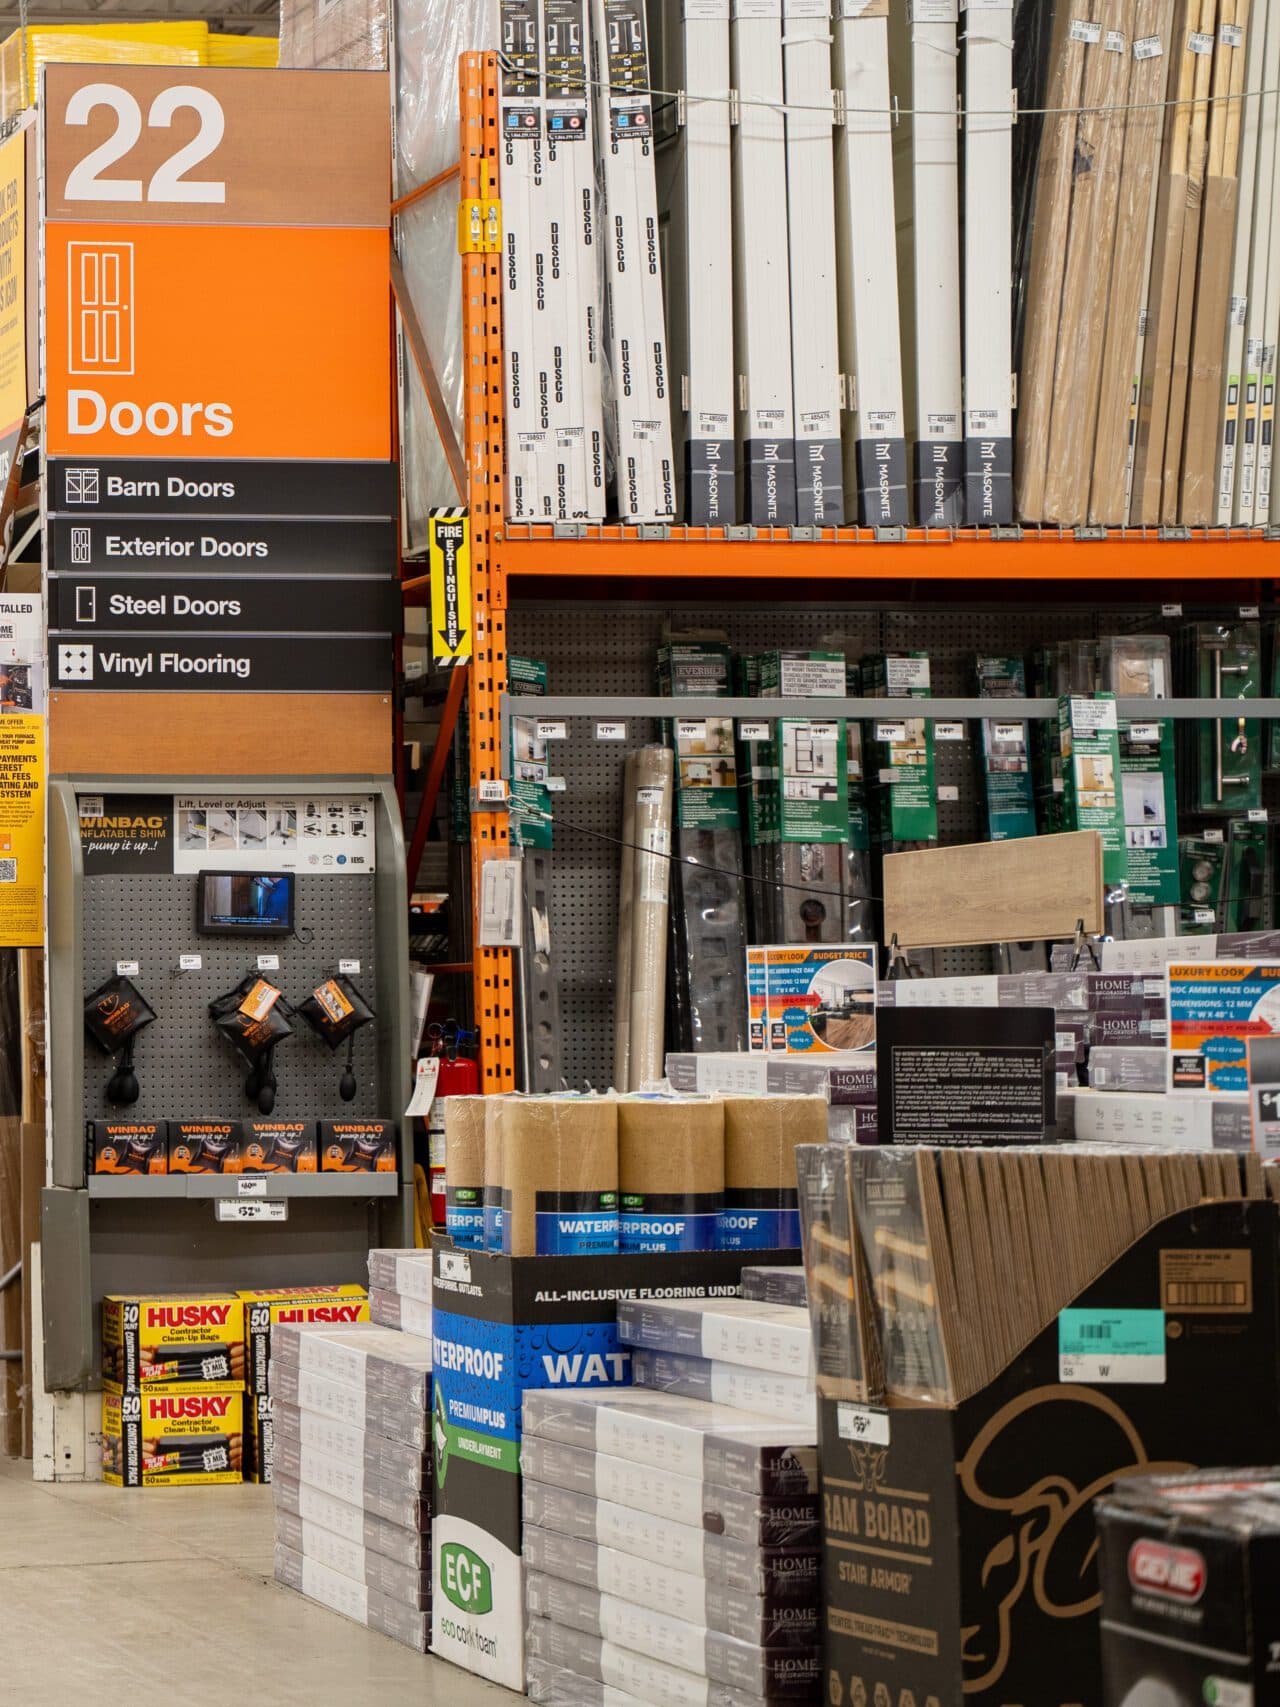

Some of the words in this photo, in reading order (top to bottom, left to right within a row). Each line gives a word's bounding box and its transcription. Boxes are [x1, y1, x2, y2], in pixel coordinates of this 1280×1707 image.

[64, 83, 226, 204] 22
[583, 188, 593, 246] DUSCO
[551, 222, 560, 280] DUSCO
[615, 215, 626, 273] DUSCO
[646, 216, 656, 276] DUSCO
[507, 233, 517, 291] DUSCO
[536, 253, 545, 311] DUSCO
[67, 389, 234, 437] Doors
[106, 477, 160, 498] Barn
[167, 477, 235, 498] Doors
[708, 464, 719, 518] MASONITE
[767, 465, 777, 519] MASONITE
[813, 465, 824, 520] MASONITE
[879, 464, 890, 519] MASONITE
[437, 525, 463, 539] FIRE
[105, 536, 194, 557] Exterior
[200, 537, 269, 558] Doors
[445, 539, 458, 648] EXTINGUISHER
[109, 595, 167, 615] Steel
[173, 596, 242, 616] Doors
[99, 653, 153, 678] Vinyl
[160, 653, 251, 678] Flooring
[12, 773, 31, 781] FEES
[23, 782, 39, 790] AND
[0, 790, 31, 798] SYSTEM
[178, 800, 197, 809] Lift,
[199, 800, 222, 809] Level
[236, 800, 266, 810] Adjust
[80, 816, 165, 828] WINBAG
[140, 829, 166, 838] SHIM
[813, 952, 842, 960] BUDGET
[1170, 968, 1211, 976] LUXURY
[1215, 968, 1245, 976] LOOK
[1096, 980, 1130, 990] HOME
[1171, 986, 1187, 994] HDC
[1189, 986, 1217, 994] AMBER
[1220, 986, 1241, 994] HAZE
[1243, 986, 1261, 994] OAK
[1103, 1020, 1137, 1030] HOME
[837, 1074, 872, 1084] HOME
[107, 1126, 156, 1134] WINBAG
[535, 1288, 637, 1302] ALL-INCLUSIVE
[640, 1287, 705, 1299] FLOORING
[148, 1305, 231, 1328] HUSKY
[251, 1309, 269, 1326] 50
[279, 1305, 363, 1323] HUSKY
[162, 1335, 199, 1343] Clean-Up
[200, 1334, 219, 1342] Bags
[542, 1353, 631, 1384] WAT
[1099, 1365, 1111, 1377] W
[122, 1397, 140, 1414] 50
[150, 1397, 232, 1419] HUSKY
[449, 1399, 506, 1430] PREMIUMPLUS
[163, 1426, 200, 1434] Clean-Up
[201, 1425, 220, 1433] Bags
[457, 1437, 502, 1460] UNDERLAYMENT
[771, 1507, 815, 1520] HOME
[823, 1493, 859, 1535] RAM
[864, 1500, 931, 1548] BOARD
[772, 1558, 817, 1571] HOME
[446, 1553, 482, 1601] ECF
[839, 1561, 868, 1585] STAIR
[870, 1568, 912, 1594] ARMOR
[772, 1608, 817, 1621] HOME
[441, 1616, 455, 1638] eco
[475, 1627, 497, 1658] foam
